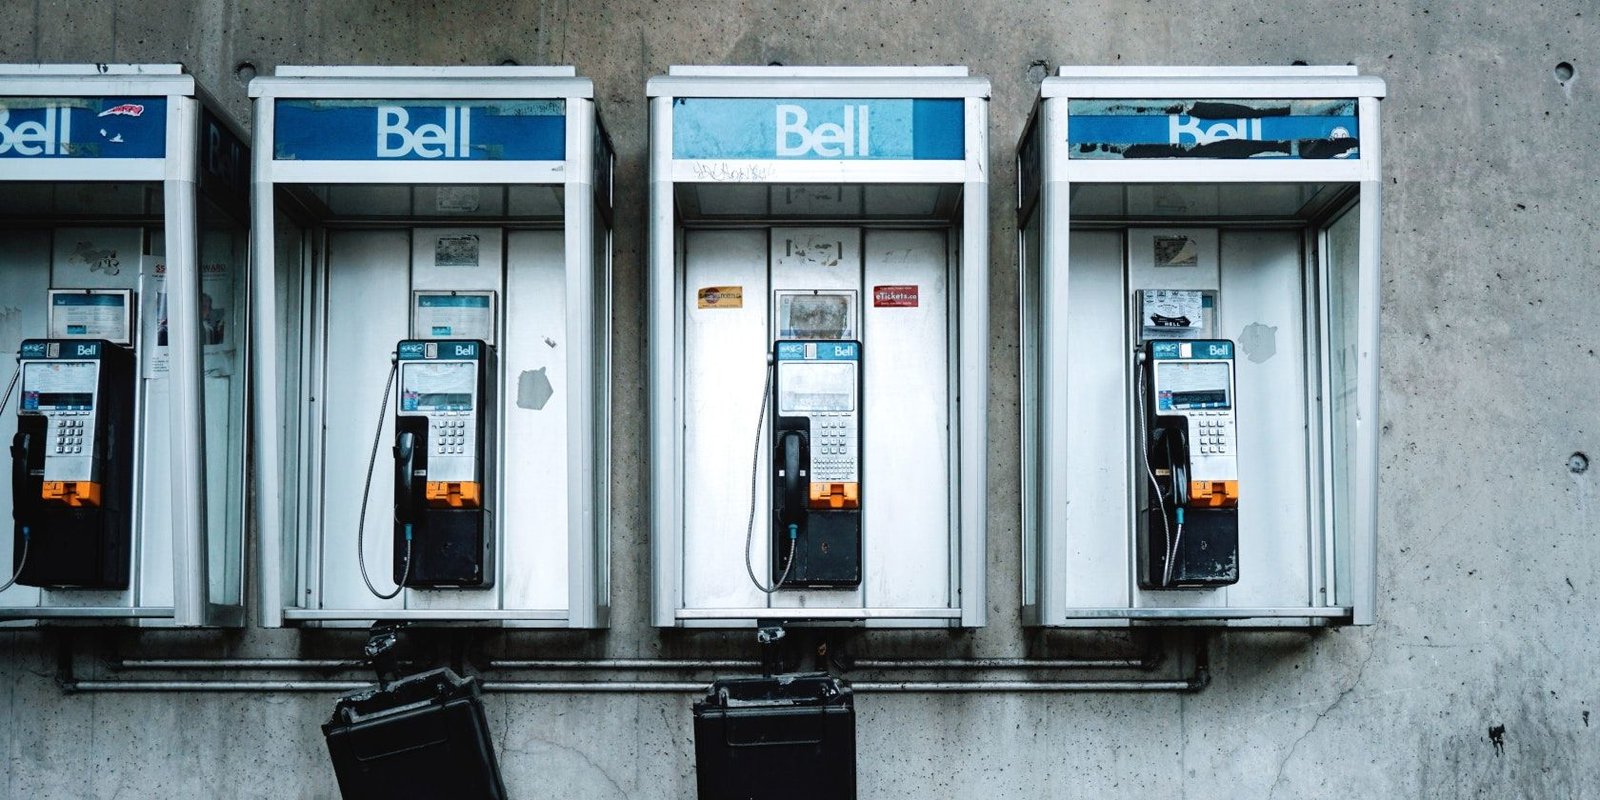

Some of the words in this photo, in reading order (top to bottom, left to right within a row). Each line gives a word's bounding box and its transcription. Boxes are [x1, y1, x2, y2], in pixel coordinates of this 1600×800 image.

[377, 106, 471, 158] Bell
[776, 104, 869, 157] Bell
[1169, 115, 1262, 146] Bell
[876, 291, 917, 300] eTickets.ca
[77, 345, 97, 355] Bell
[455, 345, 474, 356] Bell
[834, 345, 853, 356] Bell
[1209, 344, 1229, 356] Bell
